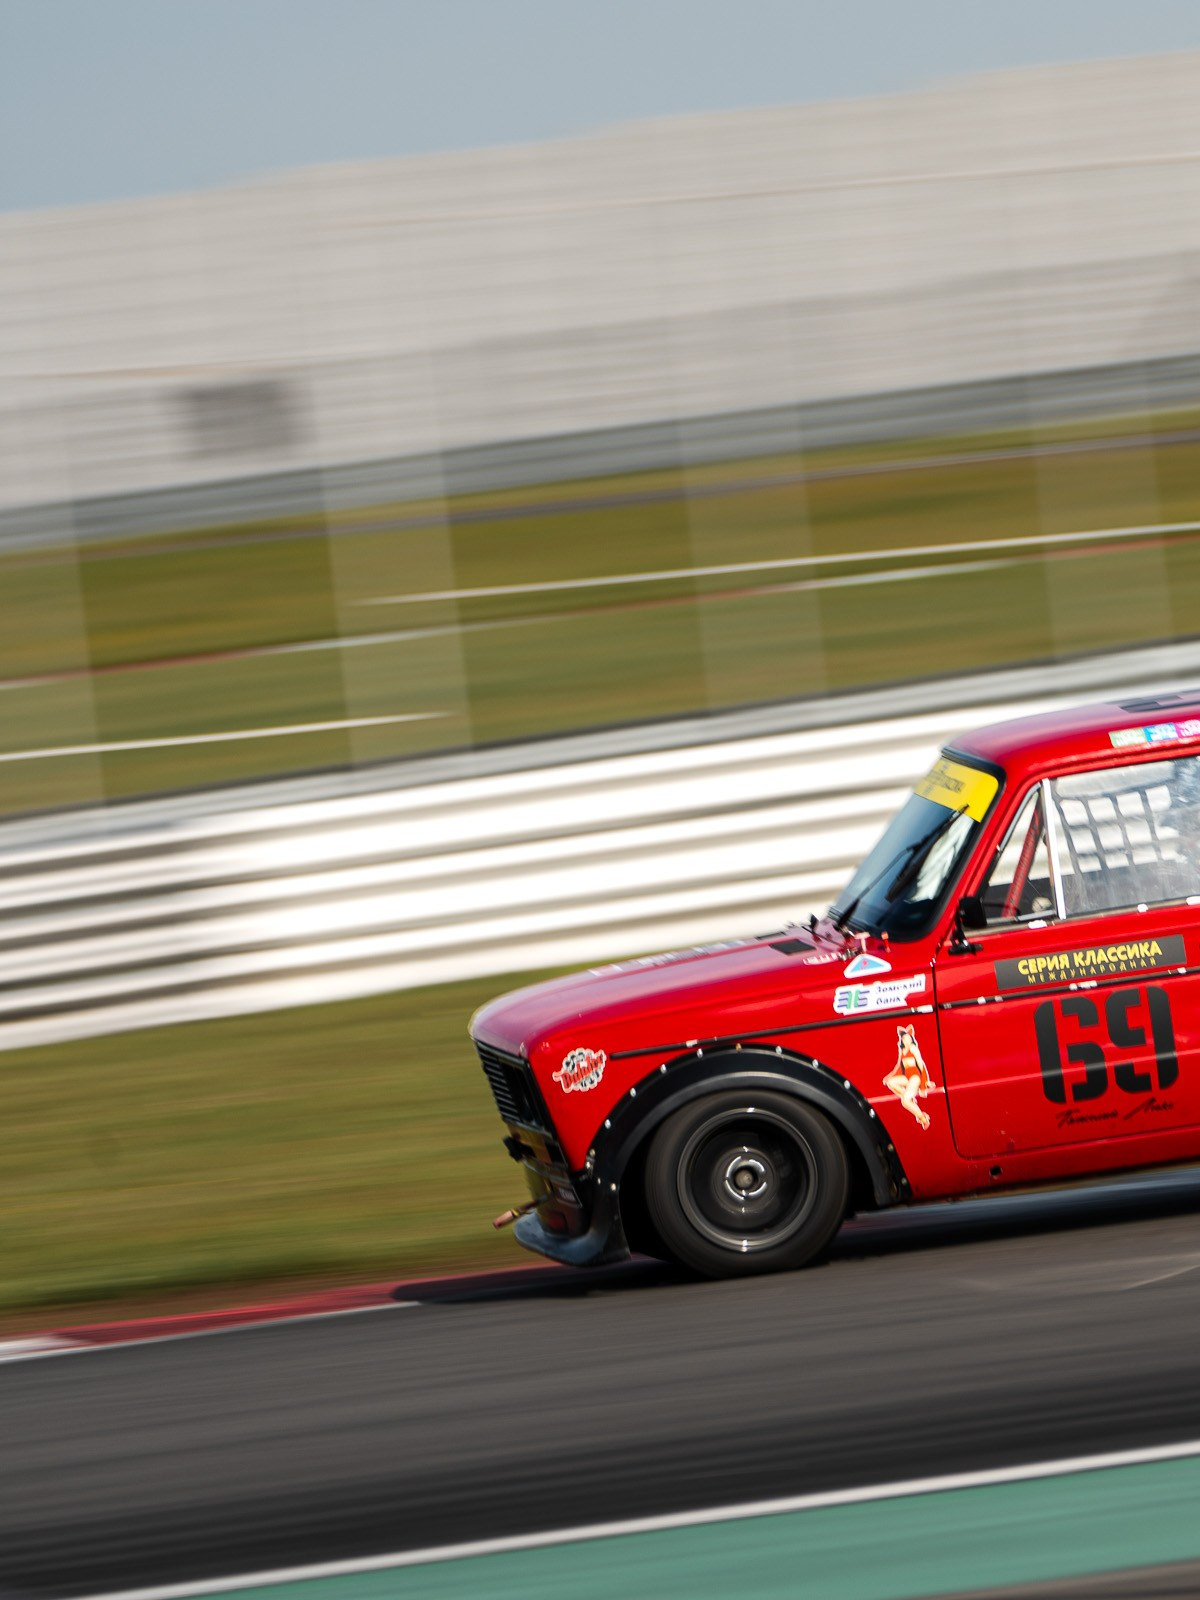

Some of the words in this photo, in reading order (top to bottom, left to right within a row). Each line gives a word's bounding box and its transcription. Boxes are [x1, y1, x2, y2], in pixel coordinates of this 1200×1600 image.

[1017, 954, 1070, 975] СЕРИЯ
[1072, 940, 1163, 967] КЛАССИКА
[1027, 956, 1157, 984] МЕЖДУНАРОДНАЯ
[1033, 985, 1180, 1105] 69
